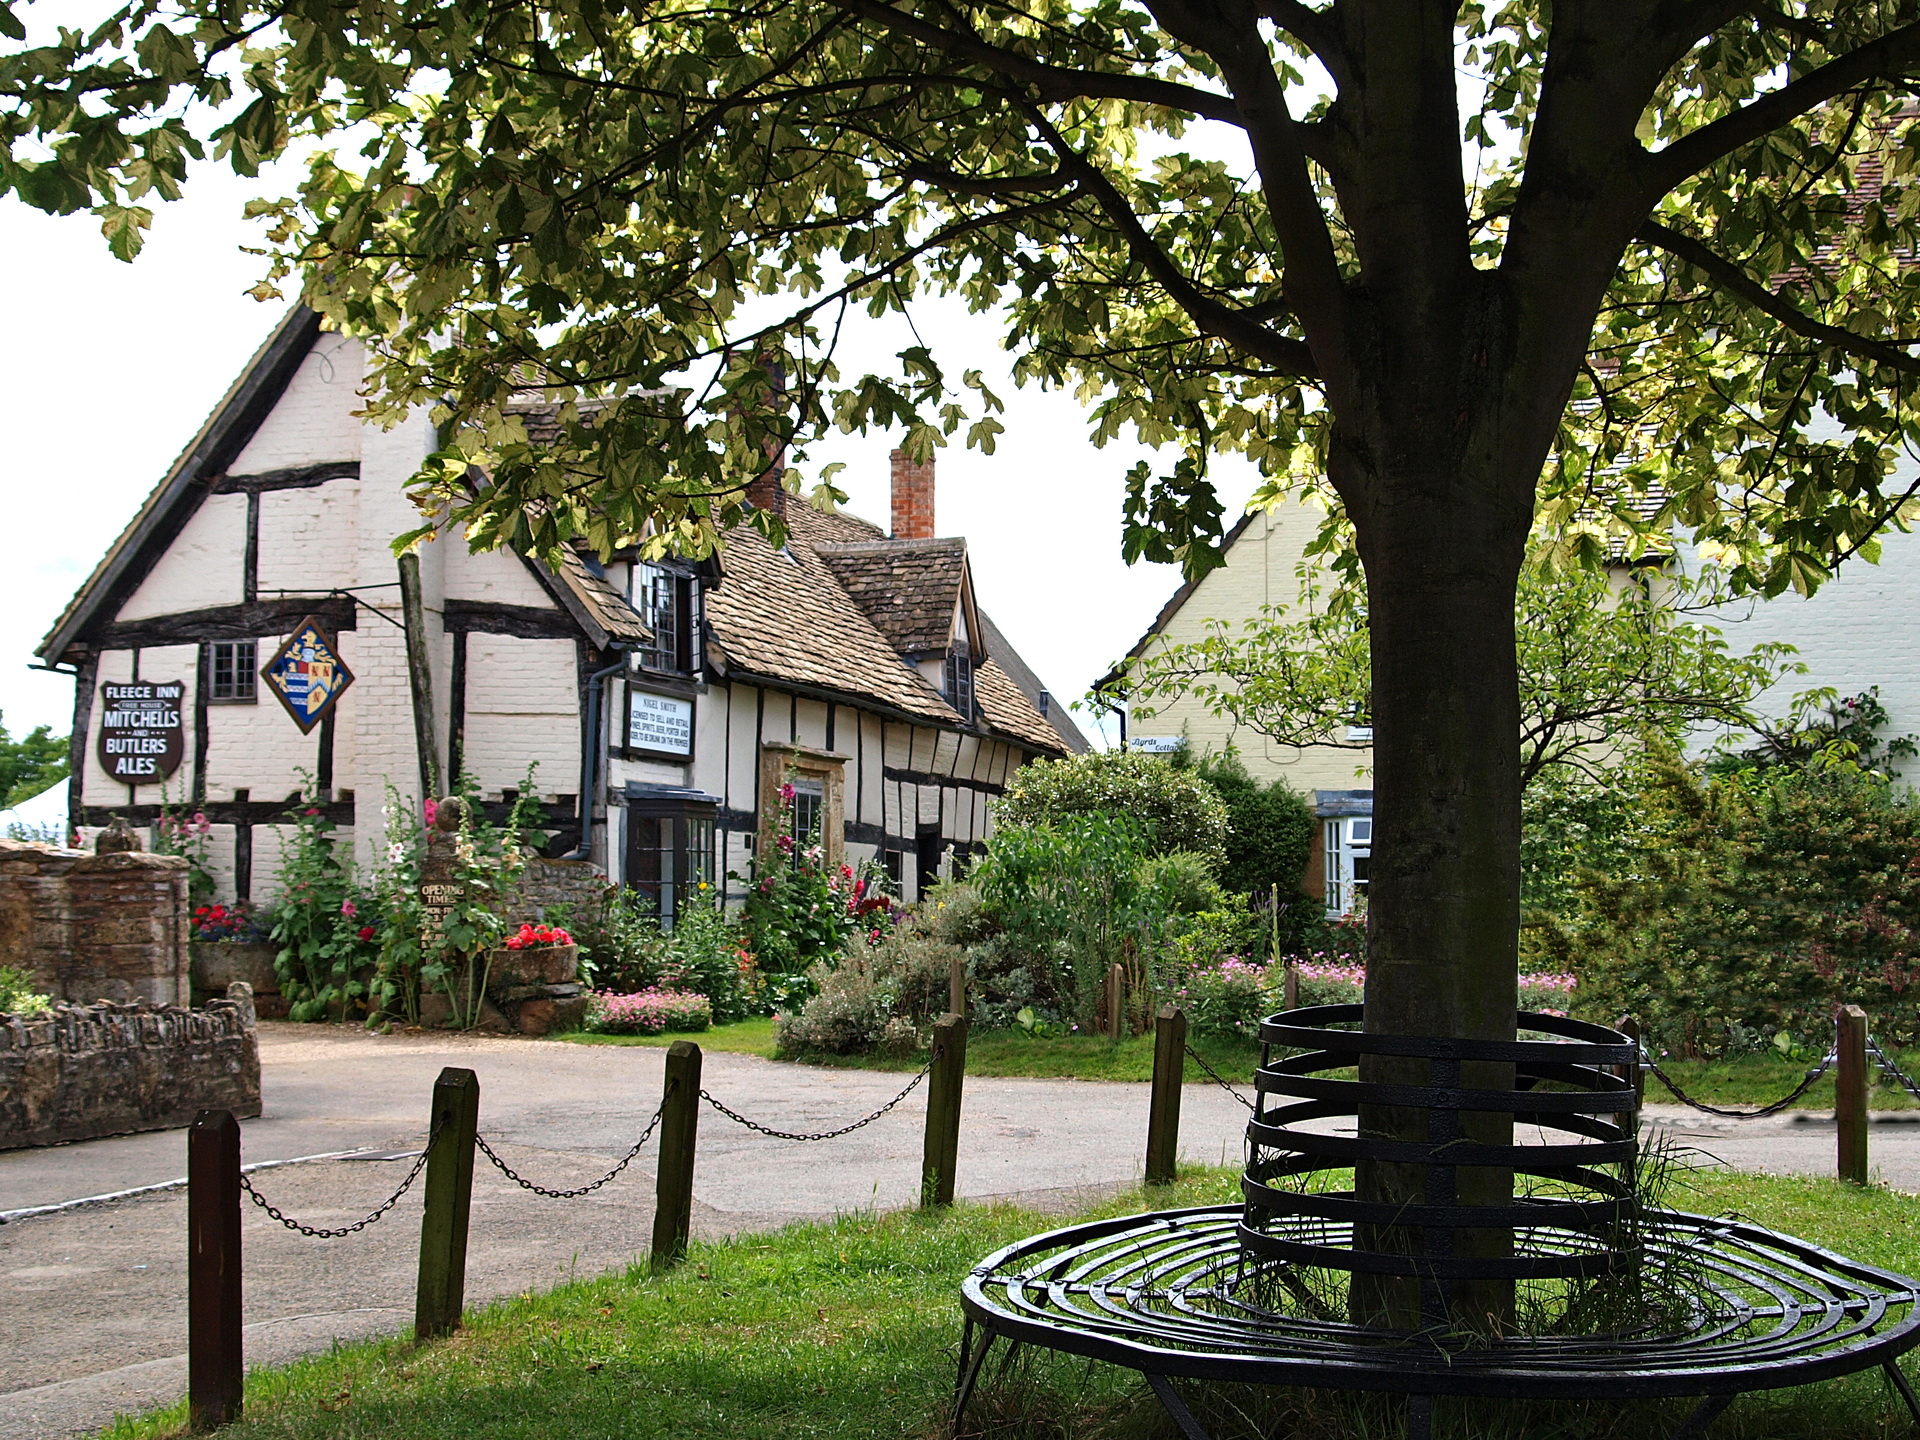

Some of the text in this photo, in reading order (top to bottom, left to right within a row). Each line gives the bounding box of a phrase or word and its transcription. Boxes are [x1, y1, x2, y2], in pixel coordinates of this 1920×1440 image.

[106, 686, 180, 699] FLEECE INN
[643, 698, 676, 713] NIGEL SMITH
[103, 710, 180, 728] MITCHELLS
[650, 713, 655, 721] TO
[656, 715, 665, 723] SELL
[676, 718, 688, 728] RETAIL
[132, 729, 149, 737] AND
[666, 727, 679, 736] PORTER
[105, 738, 168, 754] BUTLERS
[639, 732, 643, 741] TO
[649, 734, 660, 743] DRUNK
[674, 738, 688, 748] PREMISES
[114, 757, 156, 775] ALES
